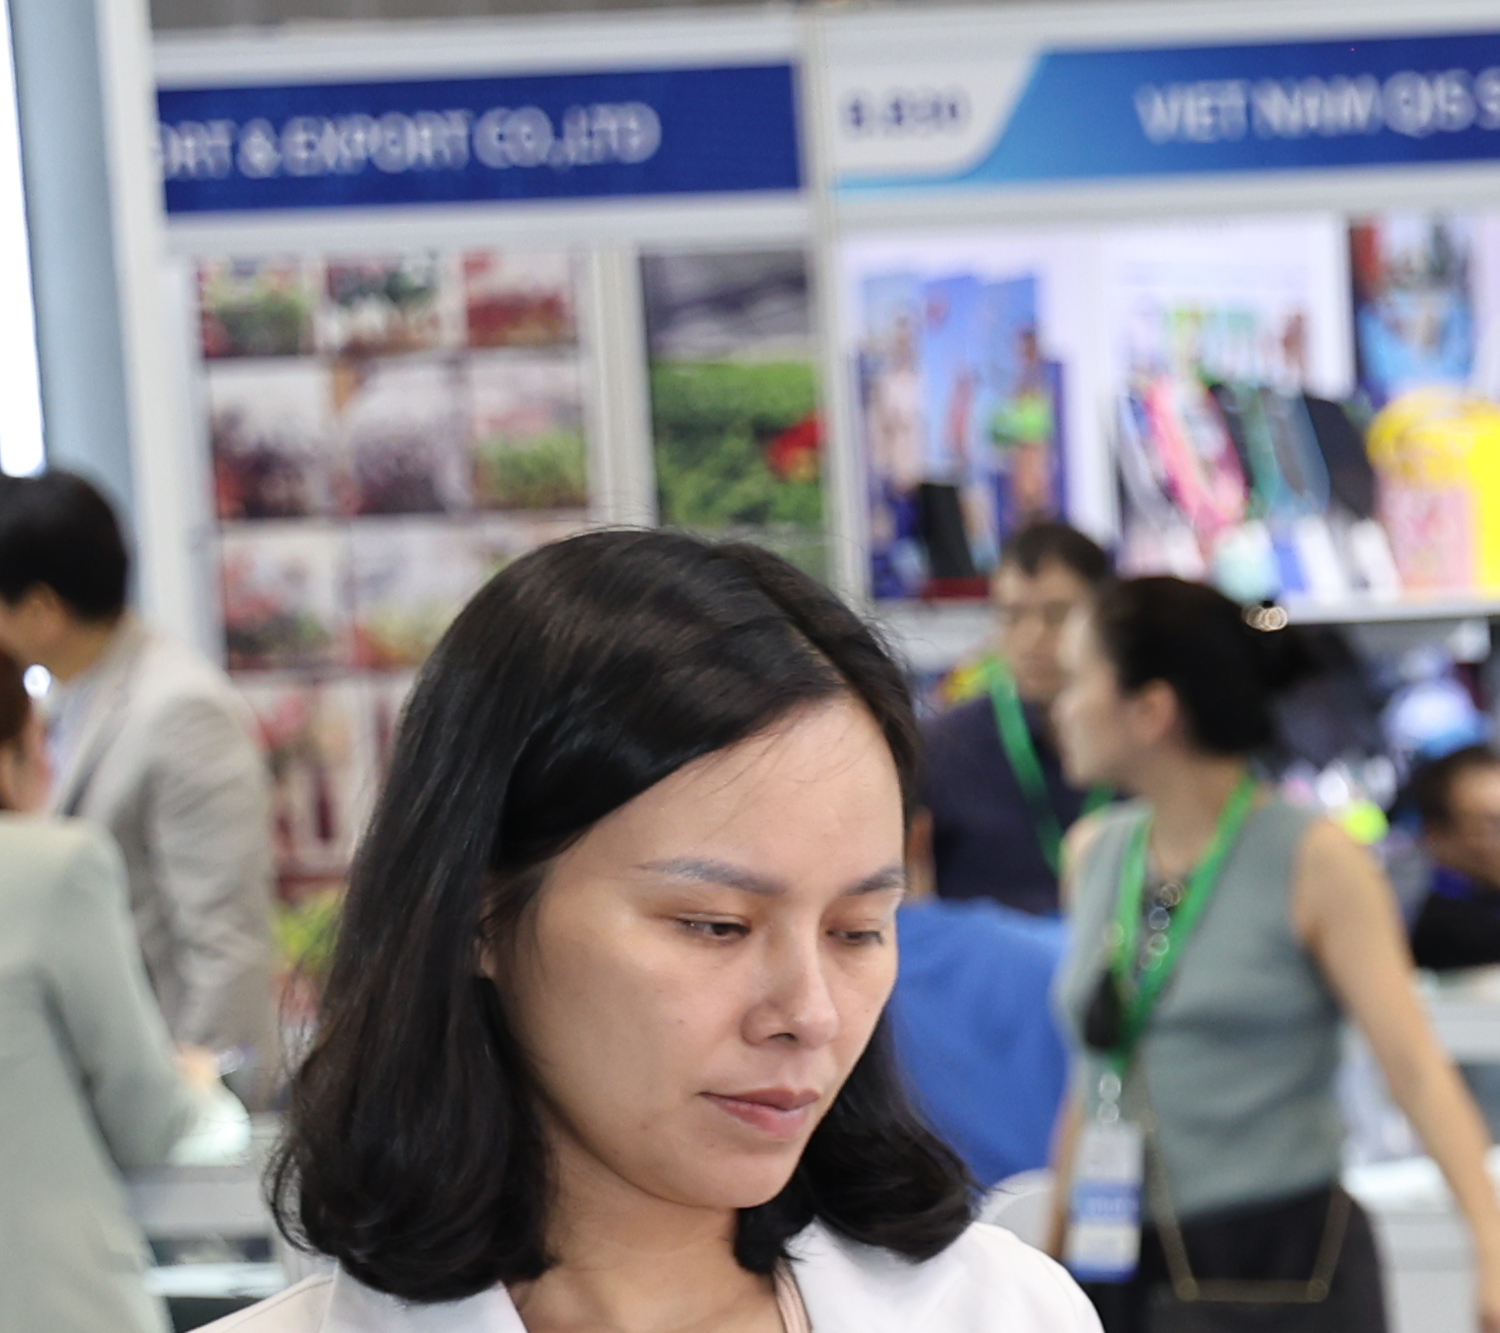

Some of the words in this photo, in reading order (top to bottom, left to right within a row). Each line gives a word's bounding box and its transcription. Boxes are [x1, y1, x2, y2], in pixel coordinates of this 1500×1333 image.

[1138, 82, 1249, 141] VIET
[1256, 77, 1380, 136] NAM
[238, 121, 288, 175] &
[286, 112, 472, 174] EXPORT
